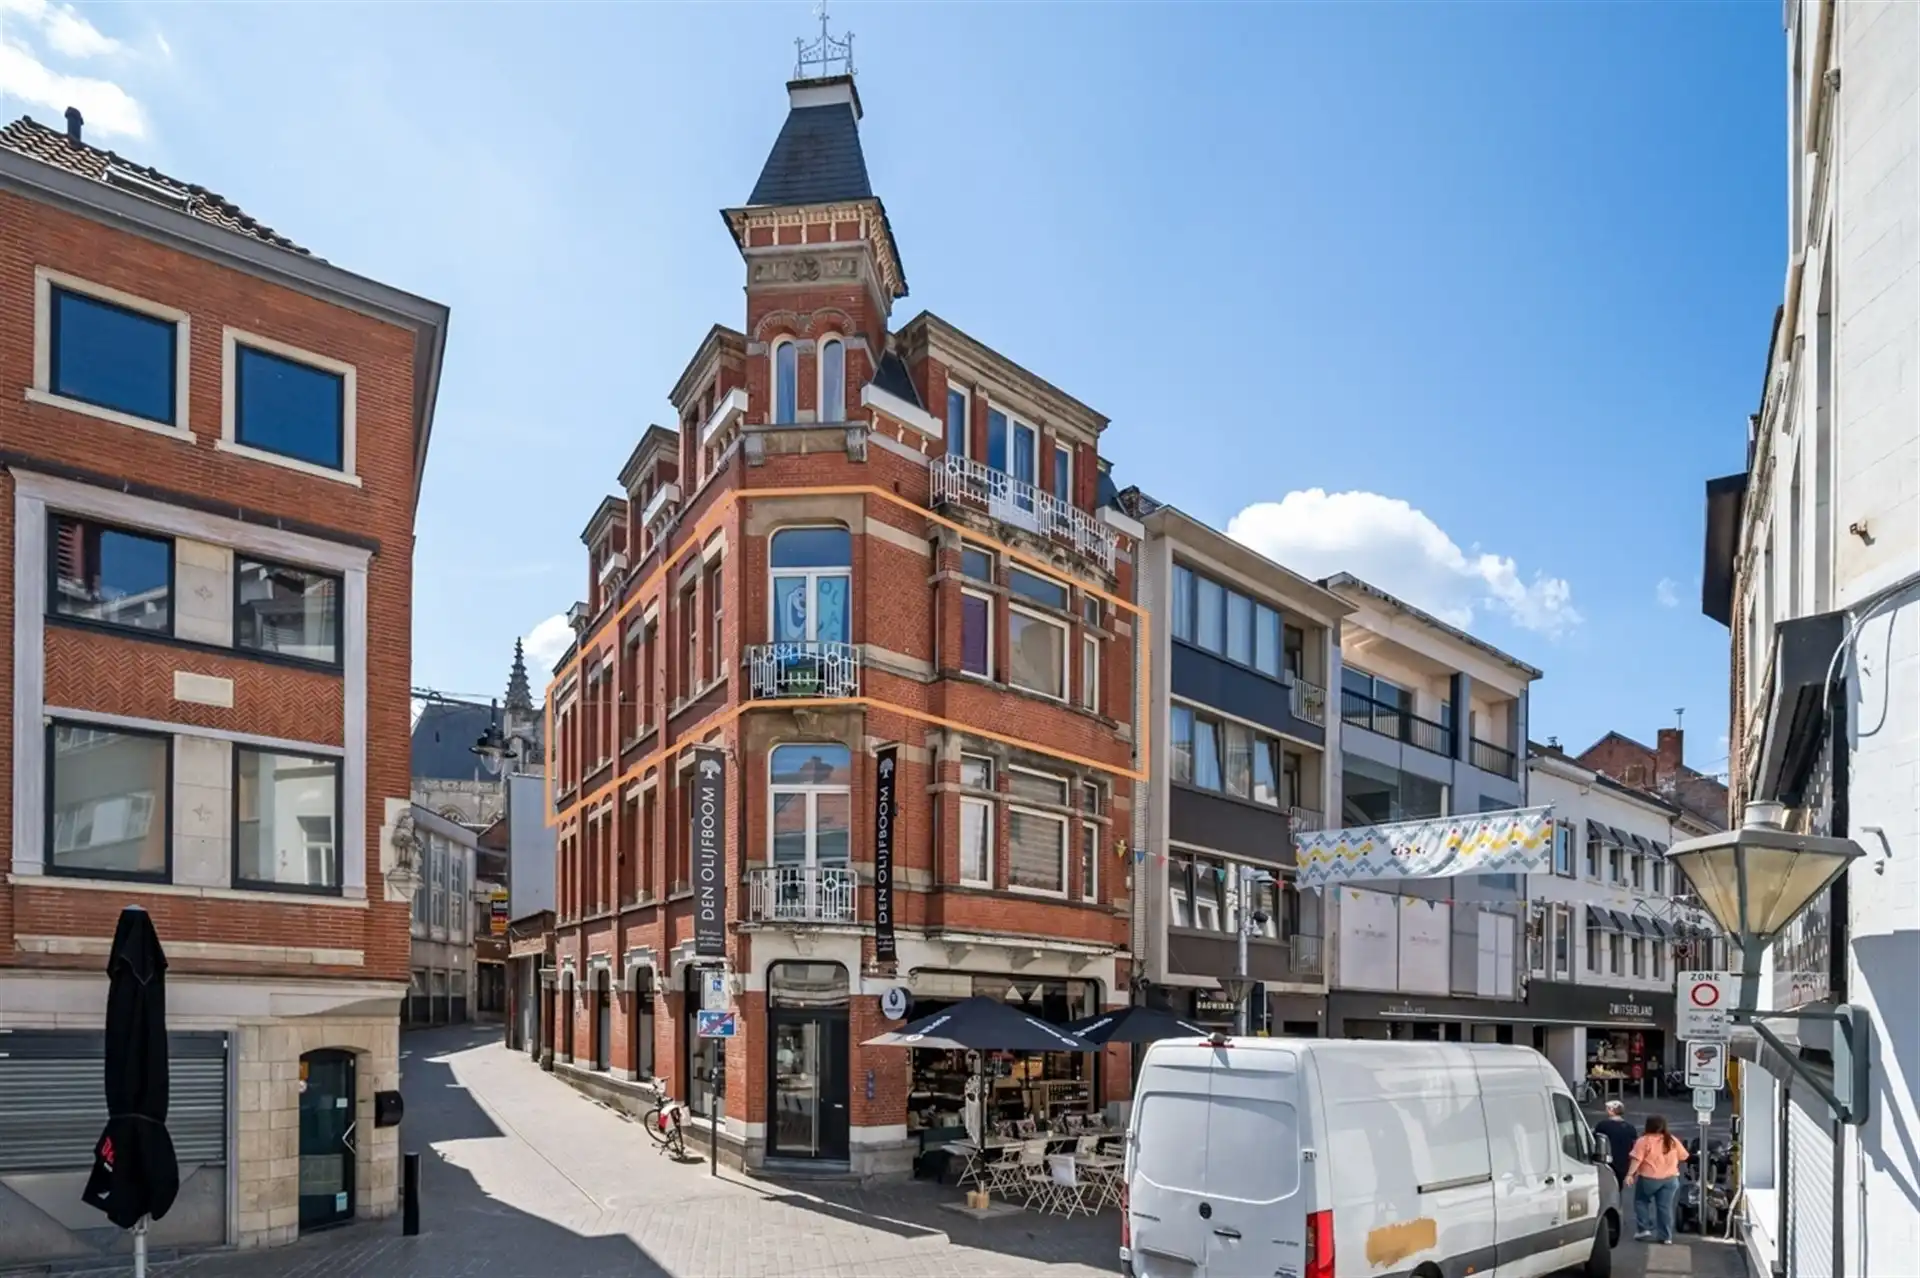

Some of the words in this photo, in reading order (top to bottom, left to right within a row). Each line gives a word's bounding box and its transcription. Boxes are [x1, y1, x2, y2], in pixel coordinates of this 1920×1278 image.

[701, 786, 718, 881] OLIJFBOOM
[878, 785, 889, 883] OLIJFBOOM
[701, 886, 715, 921] DEN
[878, 888, 888, 924] DEN
[1690, 973, 1721, 982] ZONE
[1609, 1002, 1653, 1017] ZWITSERLAND
